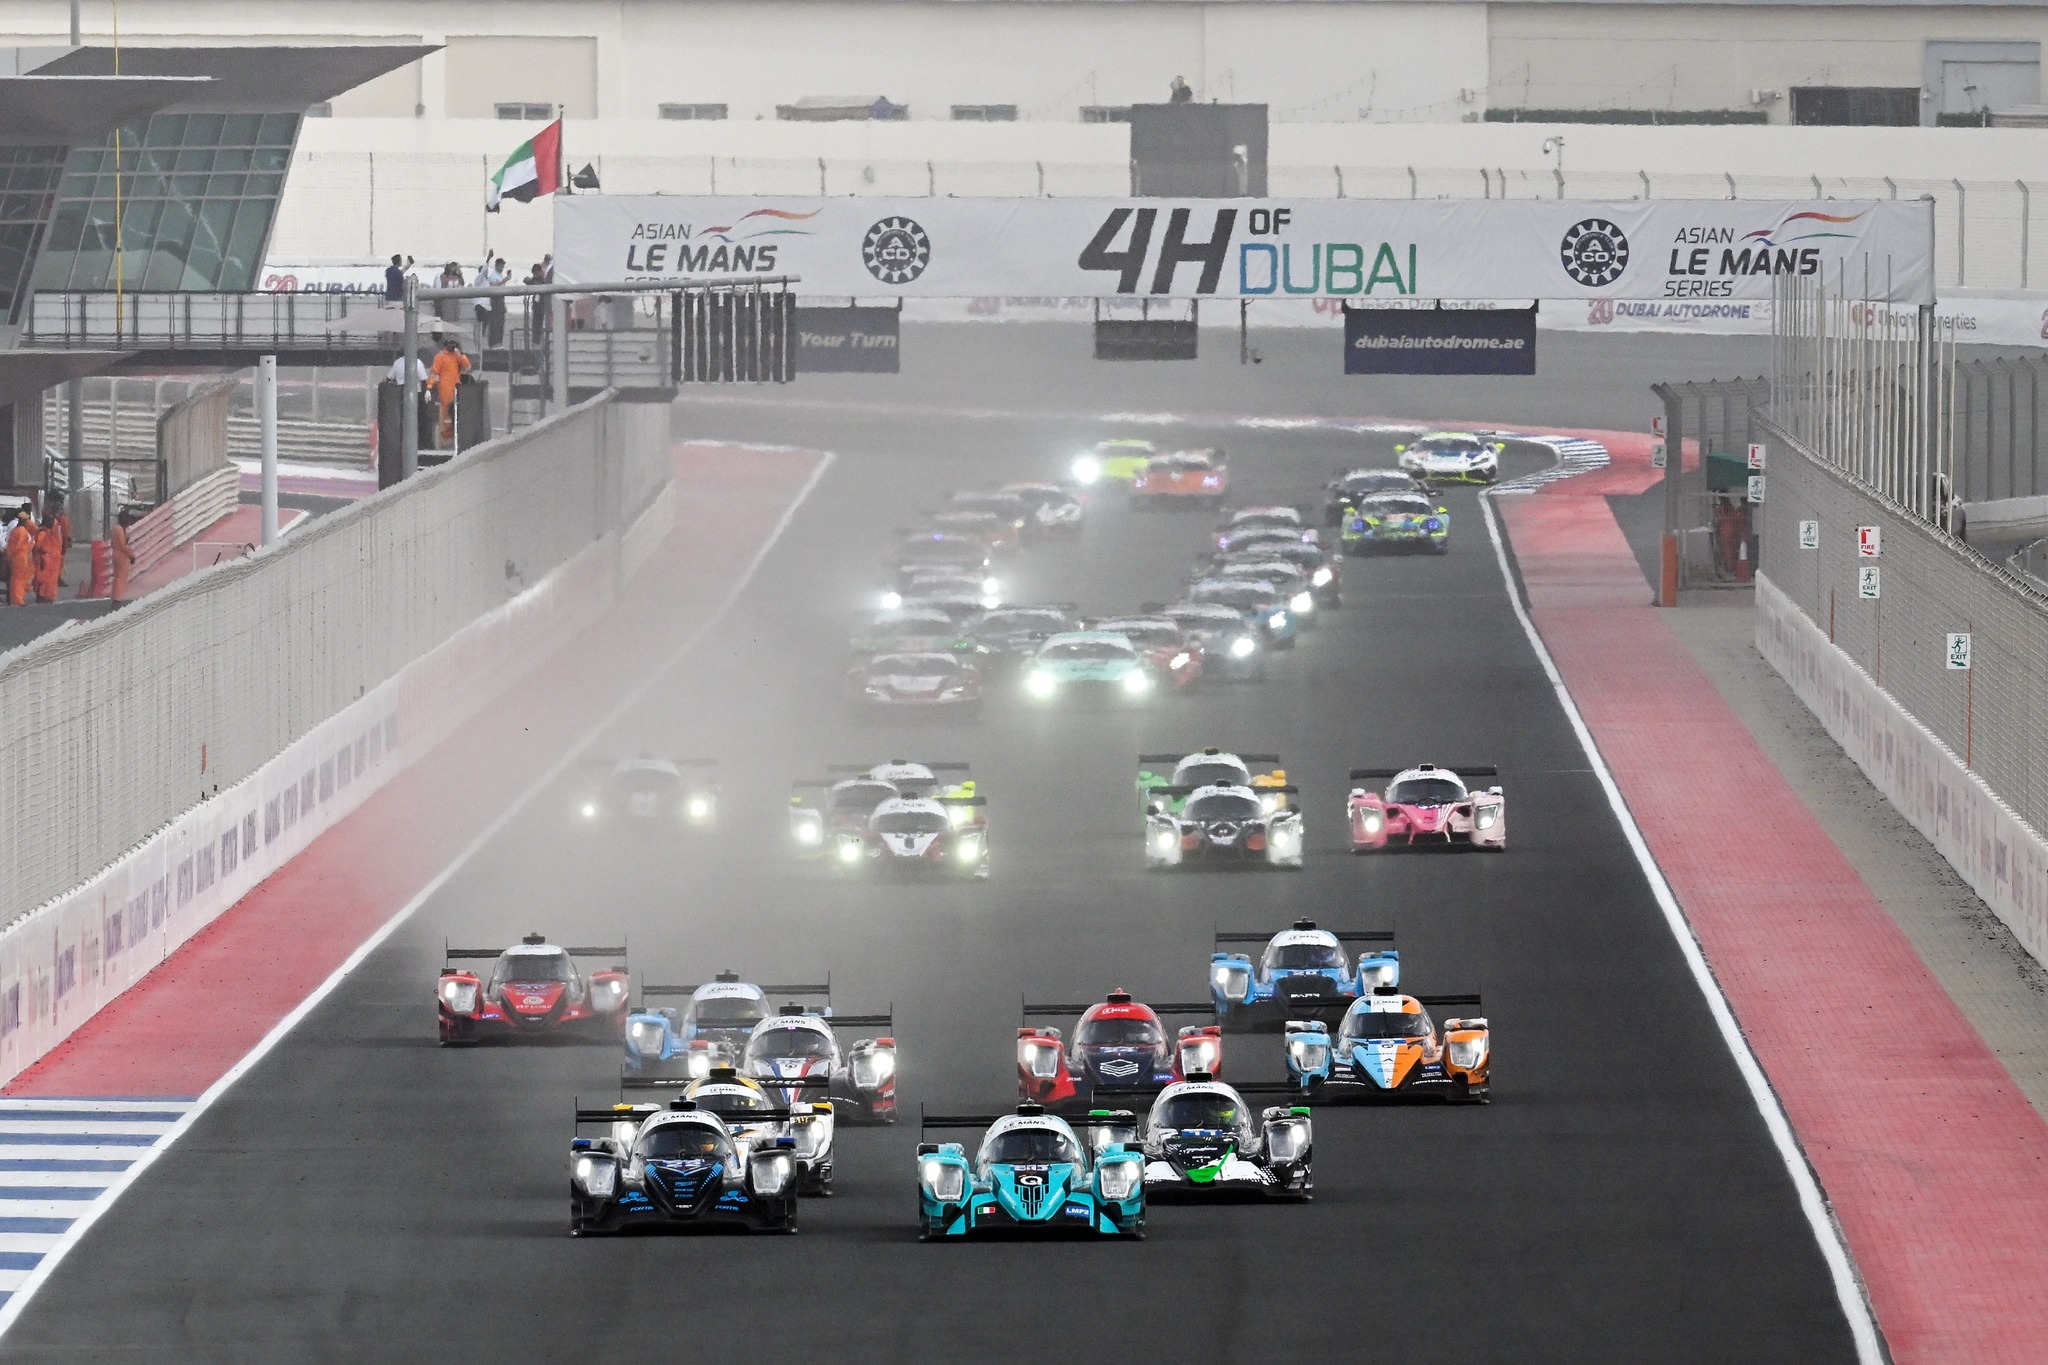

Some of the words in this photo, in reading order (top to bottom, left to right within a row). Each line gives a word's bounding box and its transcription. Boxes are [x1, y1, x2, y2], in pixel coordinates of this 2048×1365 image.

[631, 223, 692, 240] ASIAN
[1674, 227, 1735, 244] ASIAN
[626, 244, 668, 272] LE
[677, 244, 778, 272] MANS
[1078, 208, 1238, 295] 4H
[1249, 208, 1291, 235] OF
[1239, 242, 1417, 295] DUBAI
[1669, 248, 1710, 275] LE
[1719, 247, 1820, 275] MANS
[1664, 280, 1735, 297] SERIES
[1615, 302, 1661, 317] DUBAI
[1663, 304, 1751, 319] AUTODROME
[799, 332, 846, 347] Your
[850, 332, 897, 348] Turn
[1355, 334, 1525, 349] dubaiautodrome.ae
